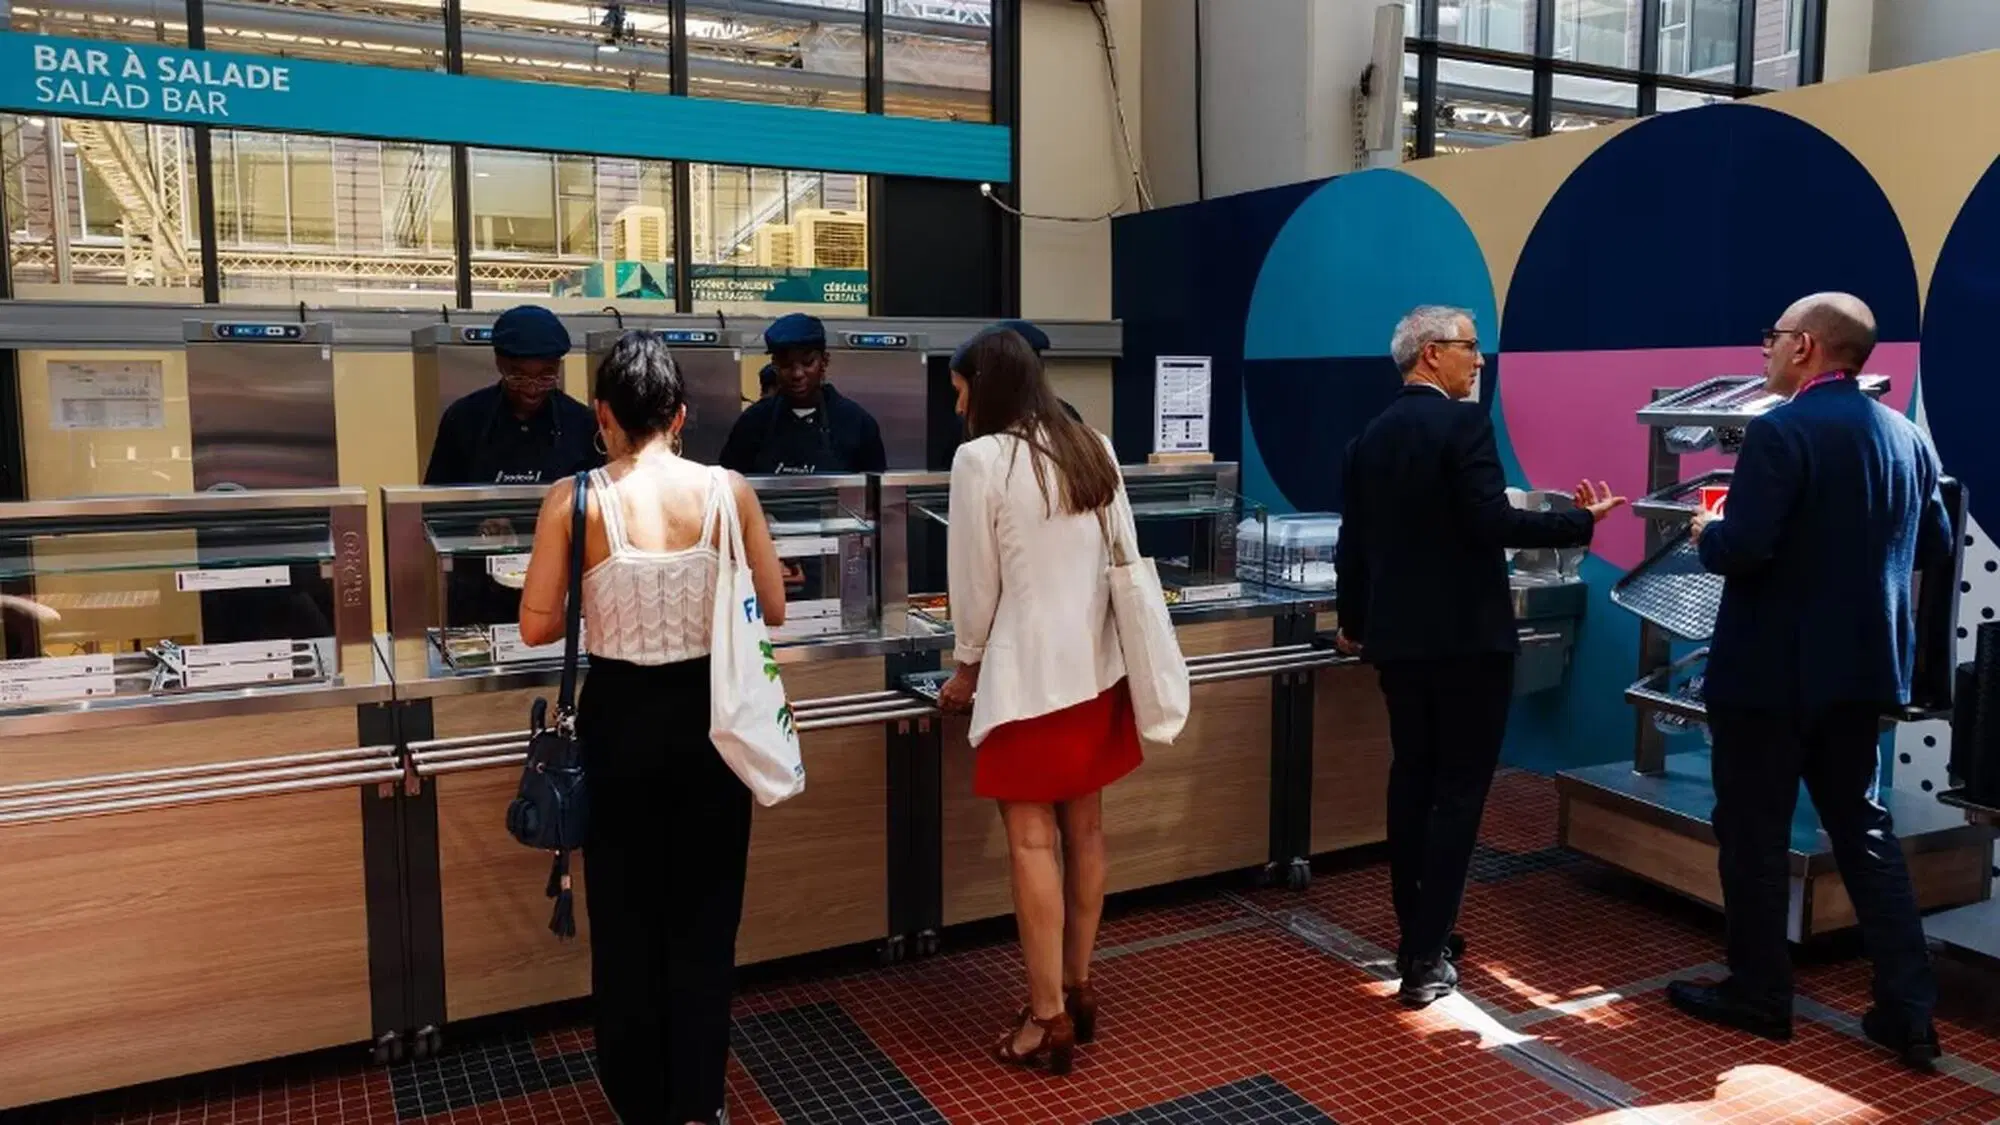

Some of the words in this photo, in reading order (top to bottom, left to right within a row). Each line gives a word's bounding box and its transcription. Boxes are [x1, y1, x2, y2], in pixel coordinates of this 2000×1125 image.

[34, 45, 110, 77] BAR
[122, 47, 146, 79] À
[157, 56, 290, 92] SALADE
[36, 76, 149, 110] SALAD
[163, 87, 228, 117] BAR
